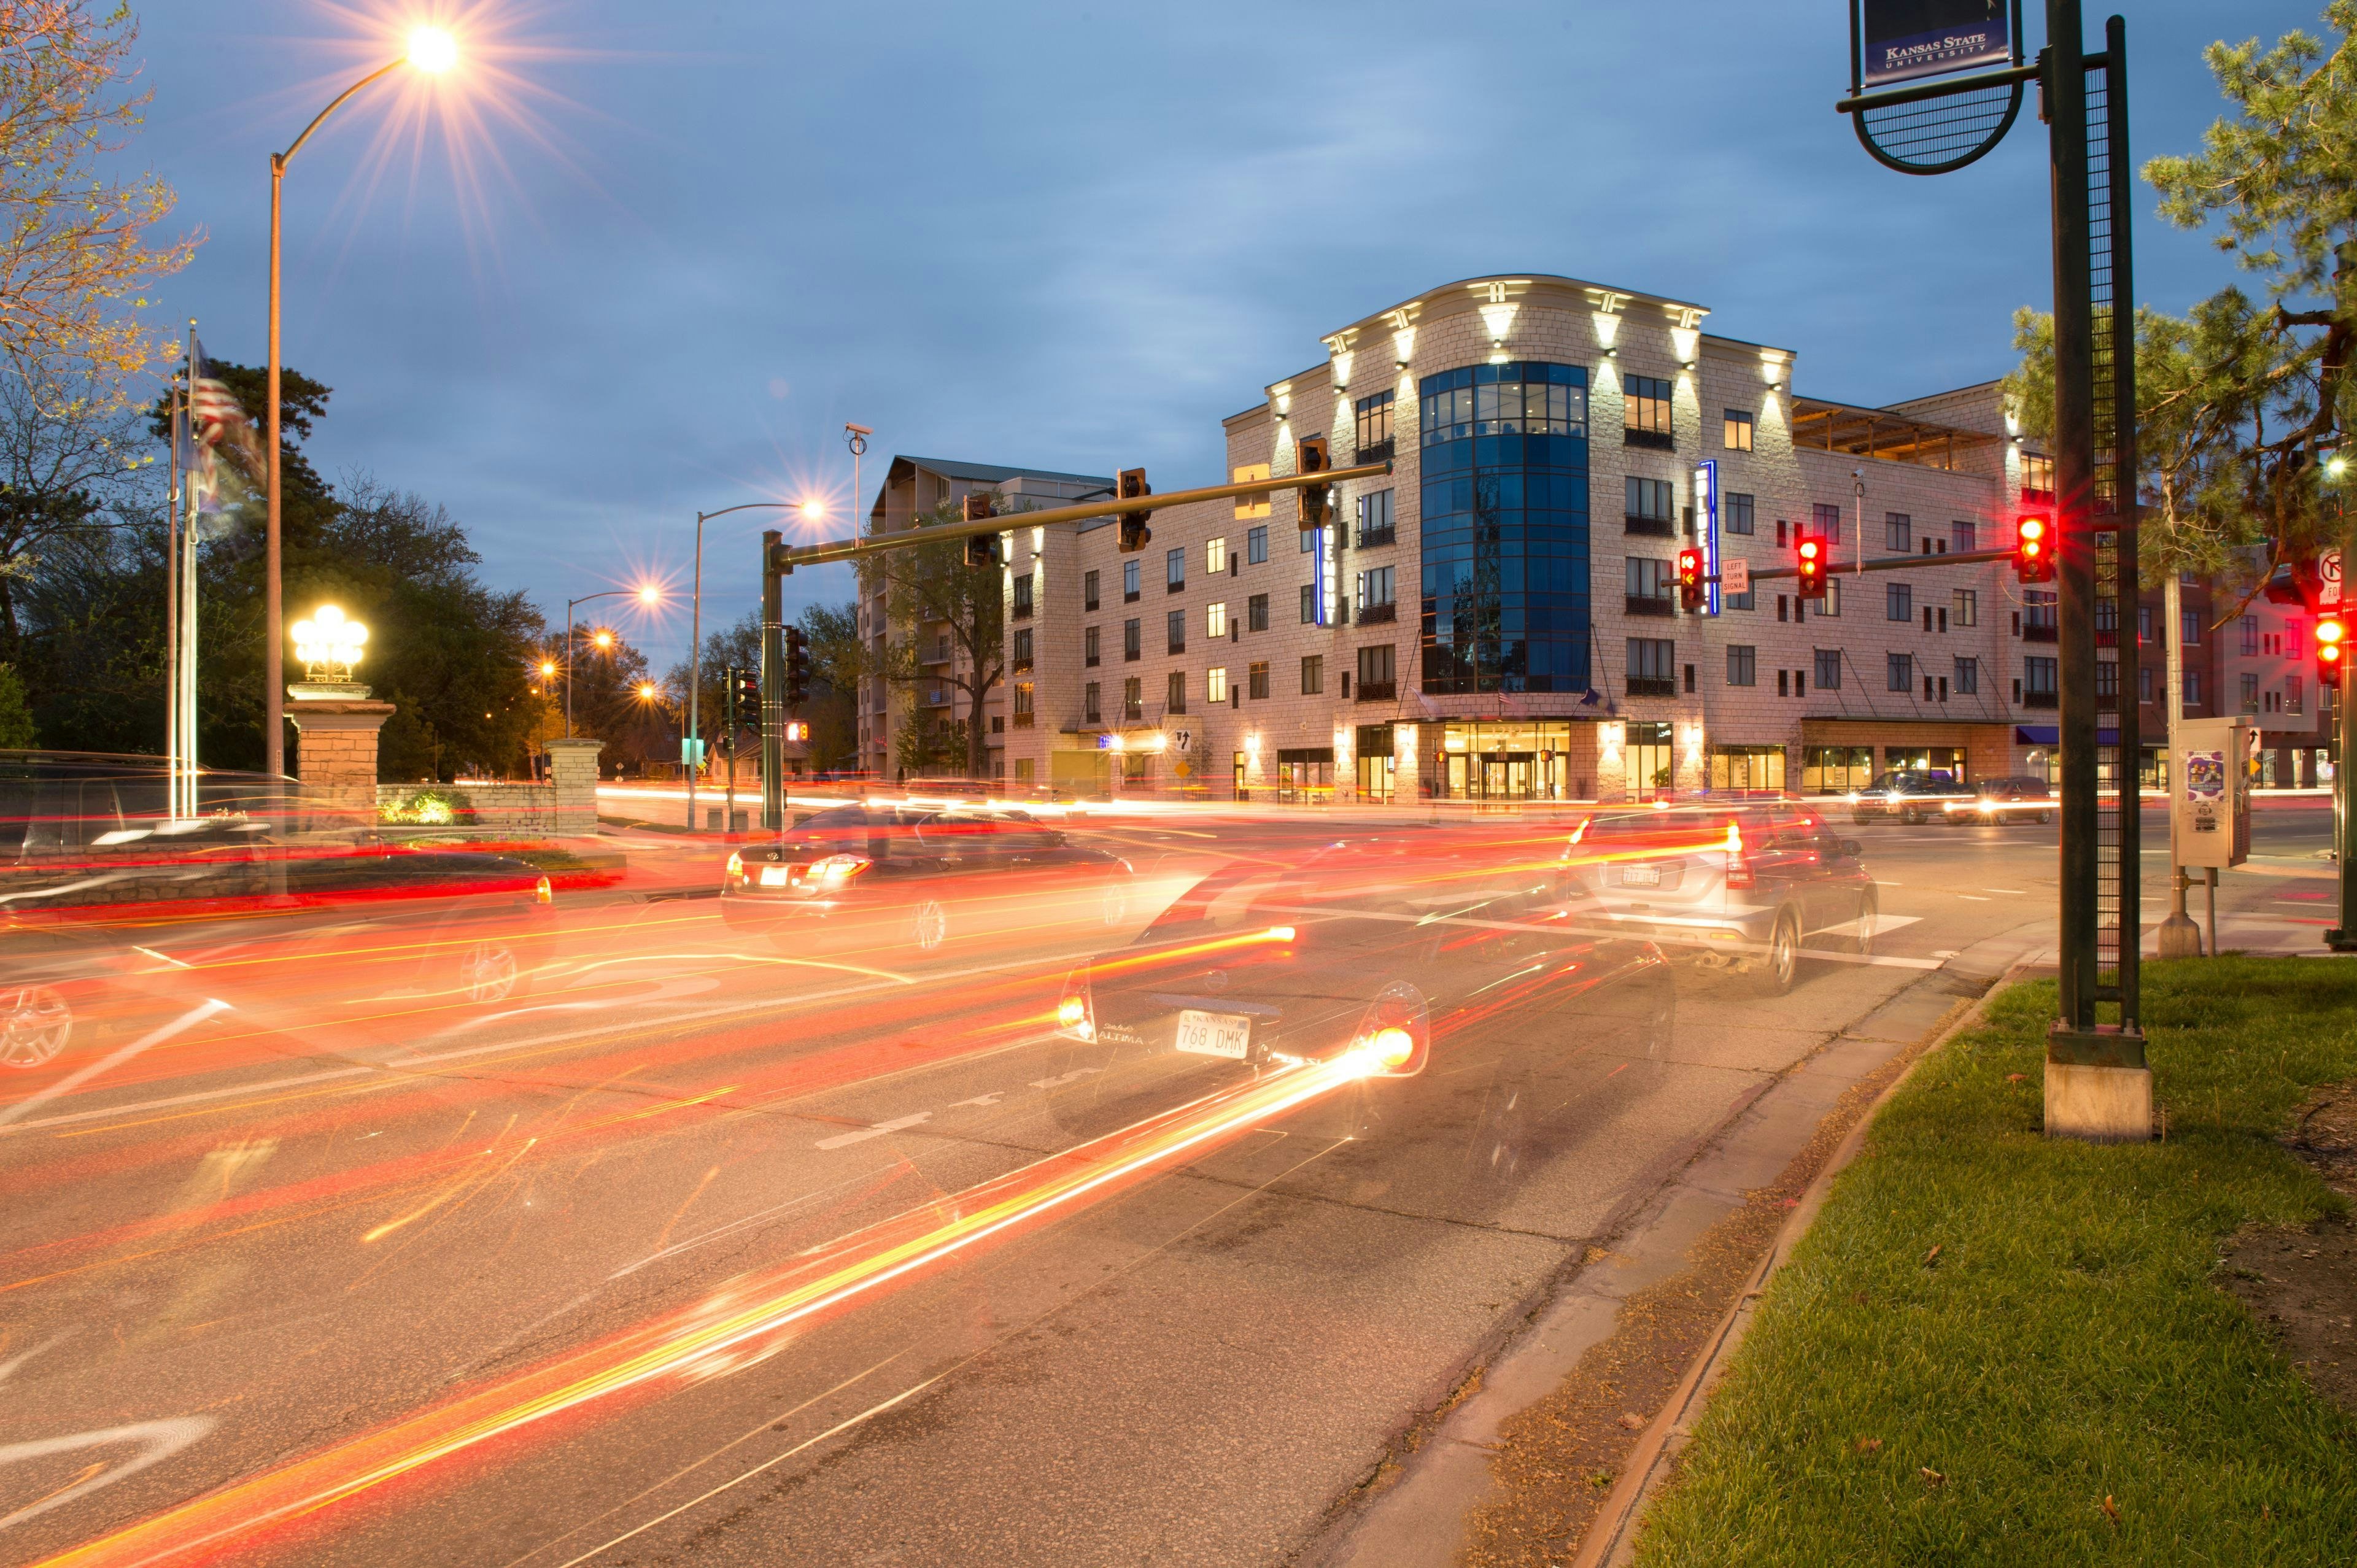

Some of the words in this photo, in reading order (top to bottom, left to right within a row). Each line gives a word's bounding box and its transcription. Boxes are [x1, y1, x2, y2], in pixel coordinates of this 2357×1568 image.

[1886, 42, 1940, 60] KANSAS
[1944, 33, 1986, 48] STATE
[1886, 45, 1985, 69] UNIVERSITY
[2328, 587, 2340, 597] FO
[1196, 1016, 1234, 1026] KANSAS
[1098, 1031, 1144, 1045] ALTIMA
[1183, 1025, 1207, 1046] 768
[1216, 1029, 1244, 1051] DMK
